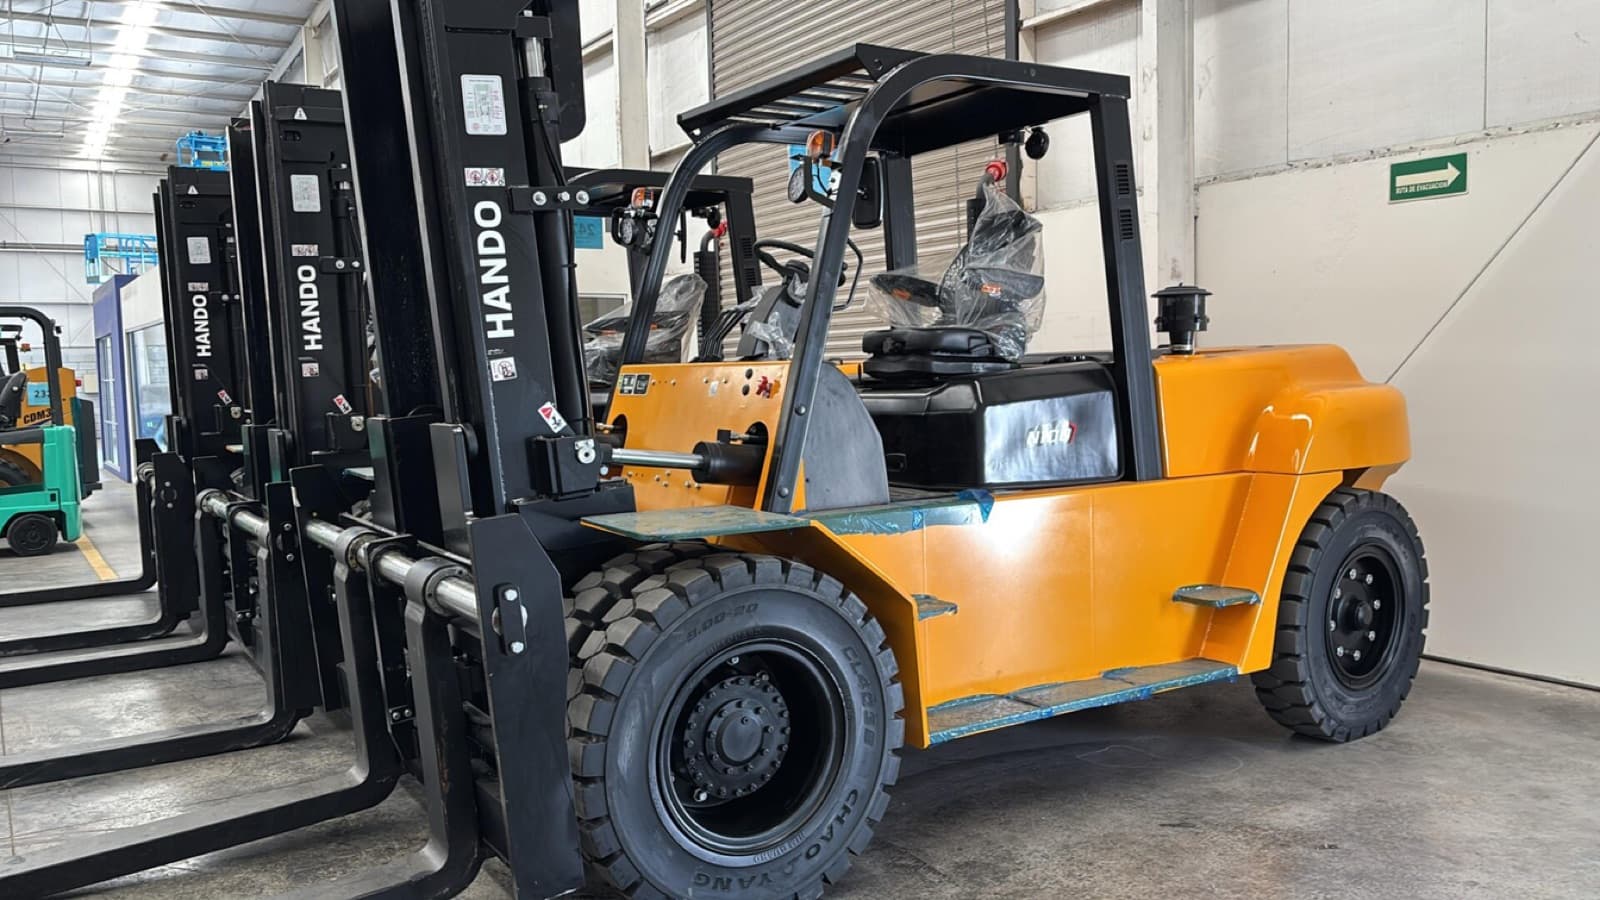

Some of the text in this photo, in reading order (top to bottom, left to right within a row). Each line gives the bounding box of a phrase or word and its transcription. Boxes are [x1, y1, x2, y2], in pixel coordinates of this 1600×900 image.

[1409, 185, 1416, 193] DE
[474, 200, 515, 339] HANDO
[192, 294, 212, 357] HANDO
[297, 264, 323, 351] HANDO
